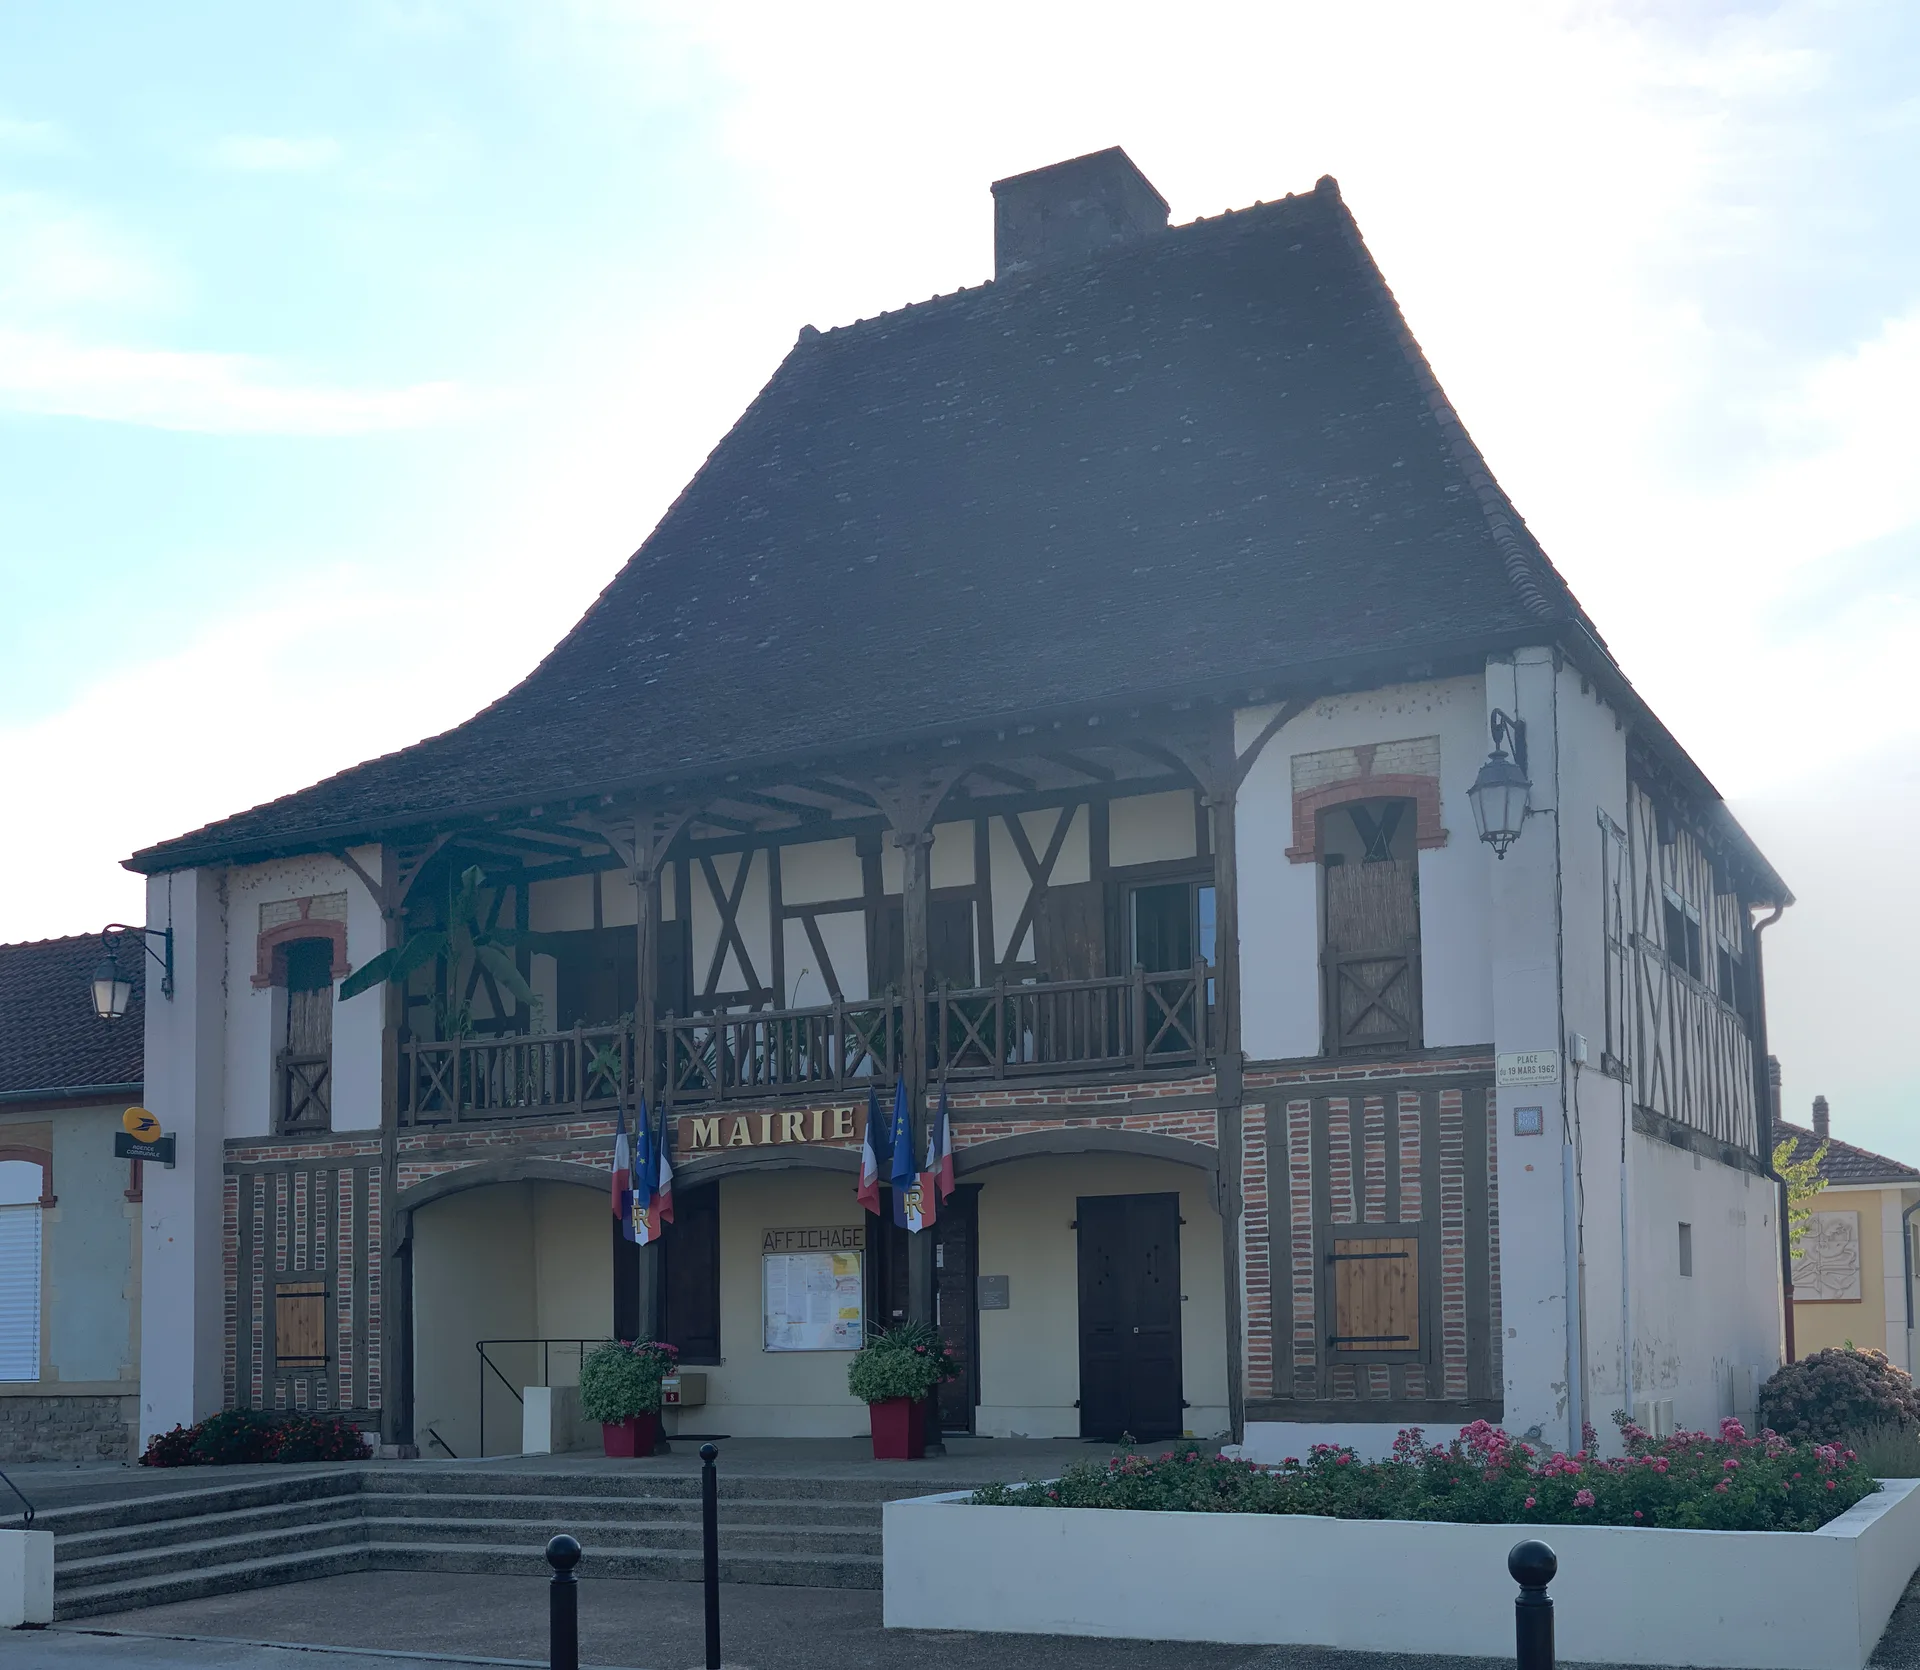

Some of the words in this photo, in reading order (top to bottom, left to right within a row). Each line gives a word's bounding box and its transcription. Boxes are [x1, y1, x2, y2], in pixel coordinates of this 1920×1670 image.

[1517, 1055, 1538, 1064] PLACE
[1500, 1068, 1506, 1076] du
[1508, 1067, 1516, 1075] 19
[1517, 1065, 1536, 1075] MARS
[1538, 1064, 1555, 1073] 1962
[690, 1107, 855, 1149] MAIRIE
[132, 1144, 155, 1152] AGENCE
[126, 1149, 161, 1158] COMMUNALE
[763, 1228, 864, 1251] AFFICHAGE
